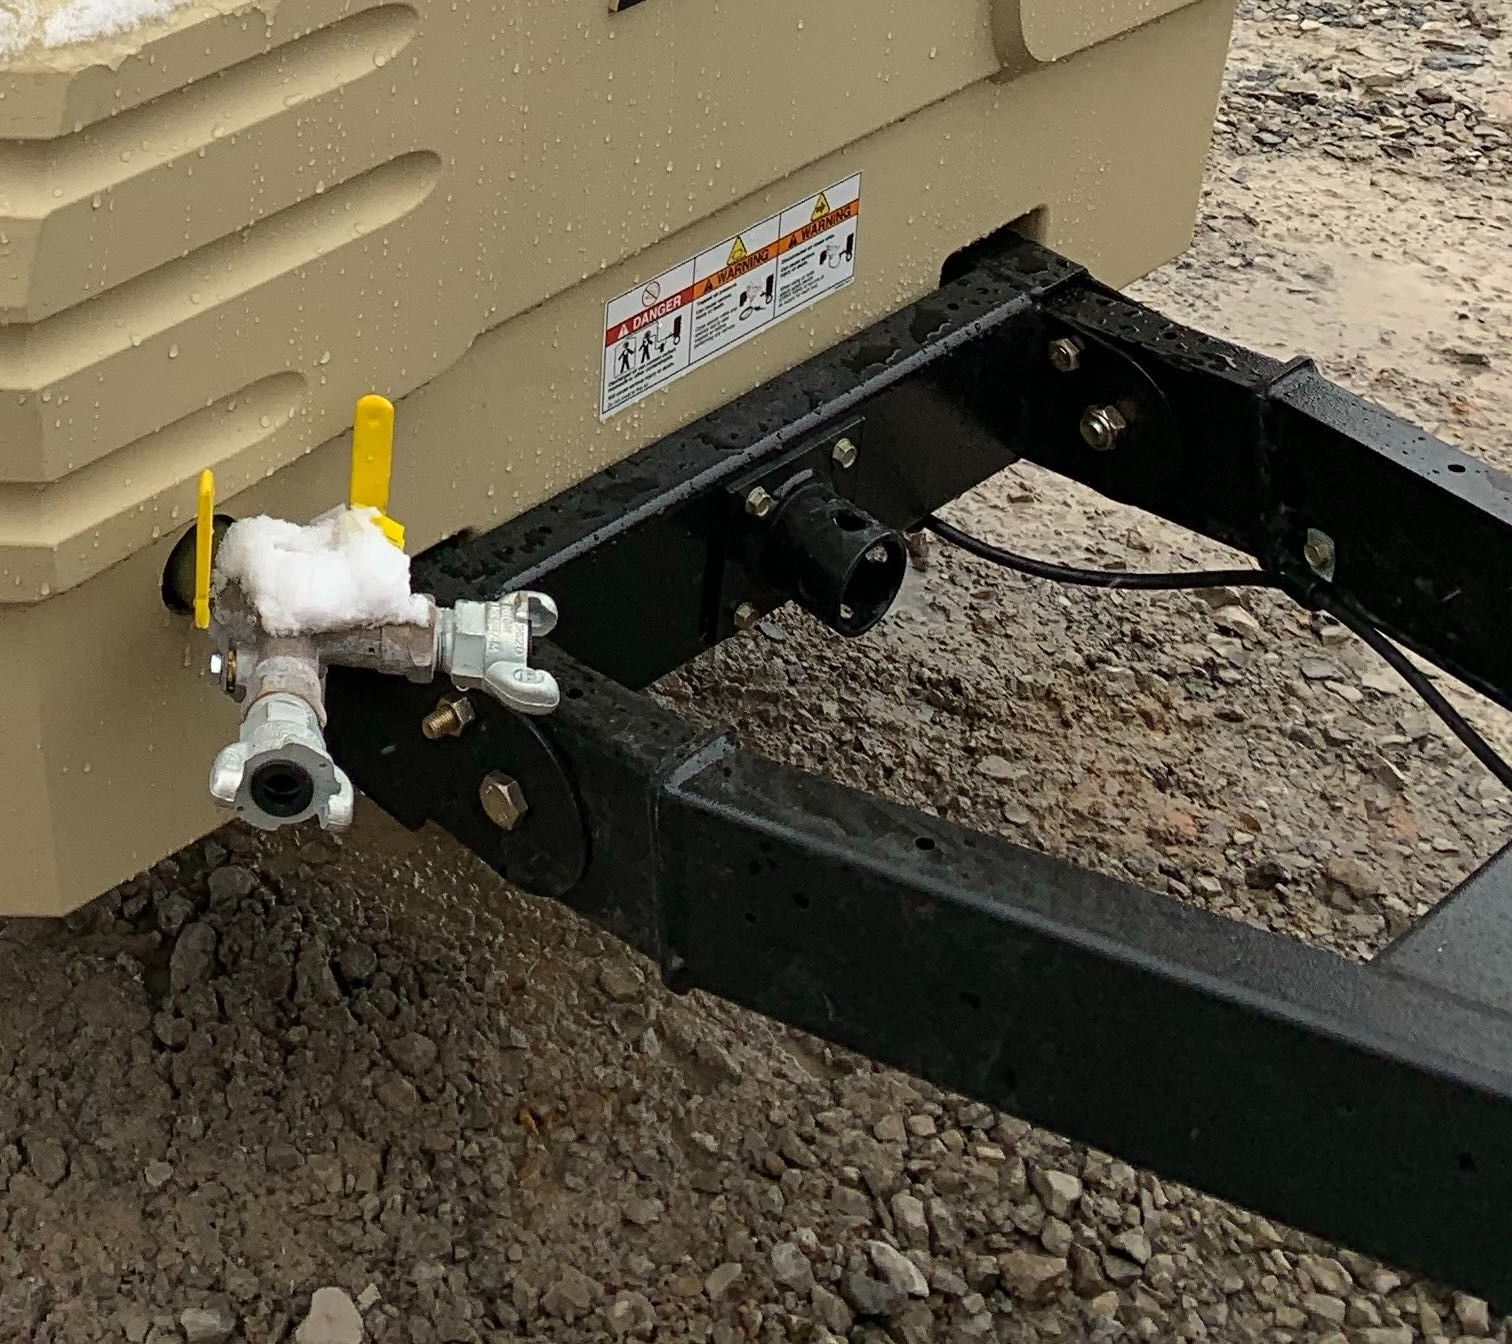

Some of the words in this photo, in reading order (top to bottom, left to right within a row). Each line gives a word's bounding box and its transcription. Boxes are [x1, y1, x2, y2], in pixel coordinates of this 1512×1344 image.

[800, 205, 852, 240] WARNING
[717, 249, 770, 284] WARNING
[632, 296, 683, 329] DANGER
